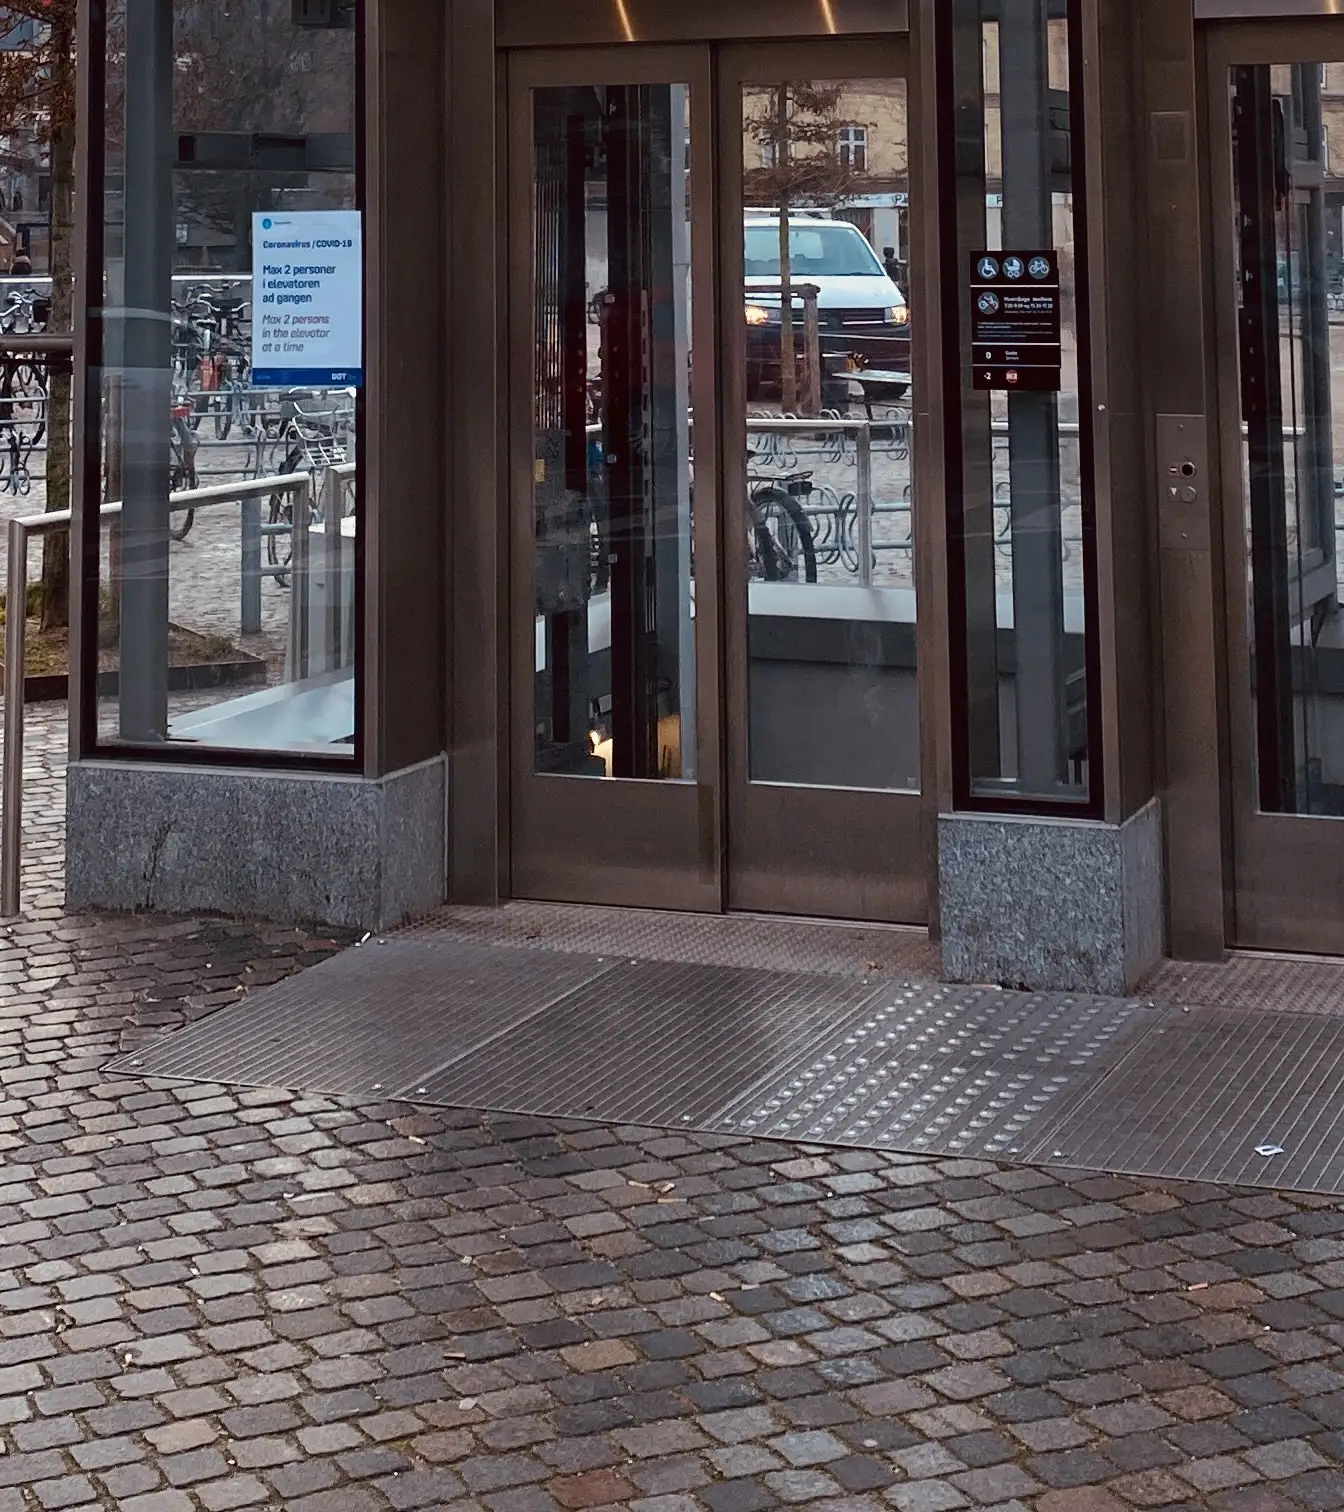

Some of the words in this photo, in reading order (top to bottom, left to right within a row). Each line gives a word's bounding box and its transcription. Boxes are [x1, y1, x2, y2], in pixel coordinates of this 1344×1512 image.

[263, 239, 311, 249] Coronavirus
[263, 265, 282, 275] Max
[284, 264, 291, 274] 2
[293, 264, 336, 277] personer
[262, 278, 266, 289] i
[268, 278, 320, 289] elevatoren
[263, 293, 275, 303] ad
[277, 293, 312, 305] gangen
[262, 314, 282, 324] Max
[283, 314, 290, 324] 2
[292, 314, 330, 326] persons
[262, 327, 271, 338] in
[273, 328, 289, 338] the
[290, 328, 330, 338] elevator
[262, 341, 273, 352] at
[274, 344, 281, 352] a
[283, 341, 305, 352] time
